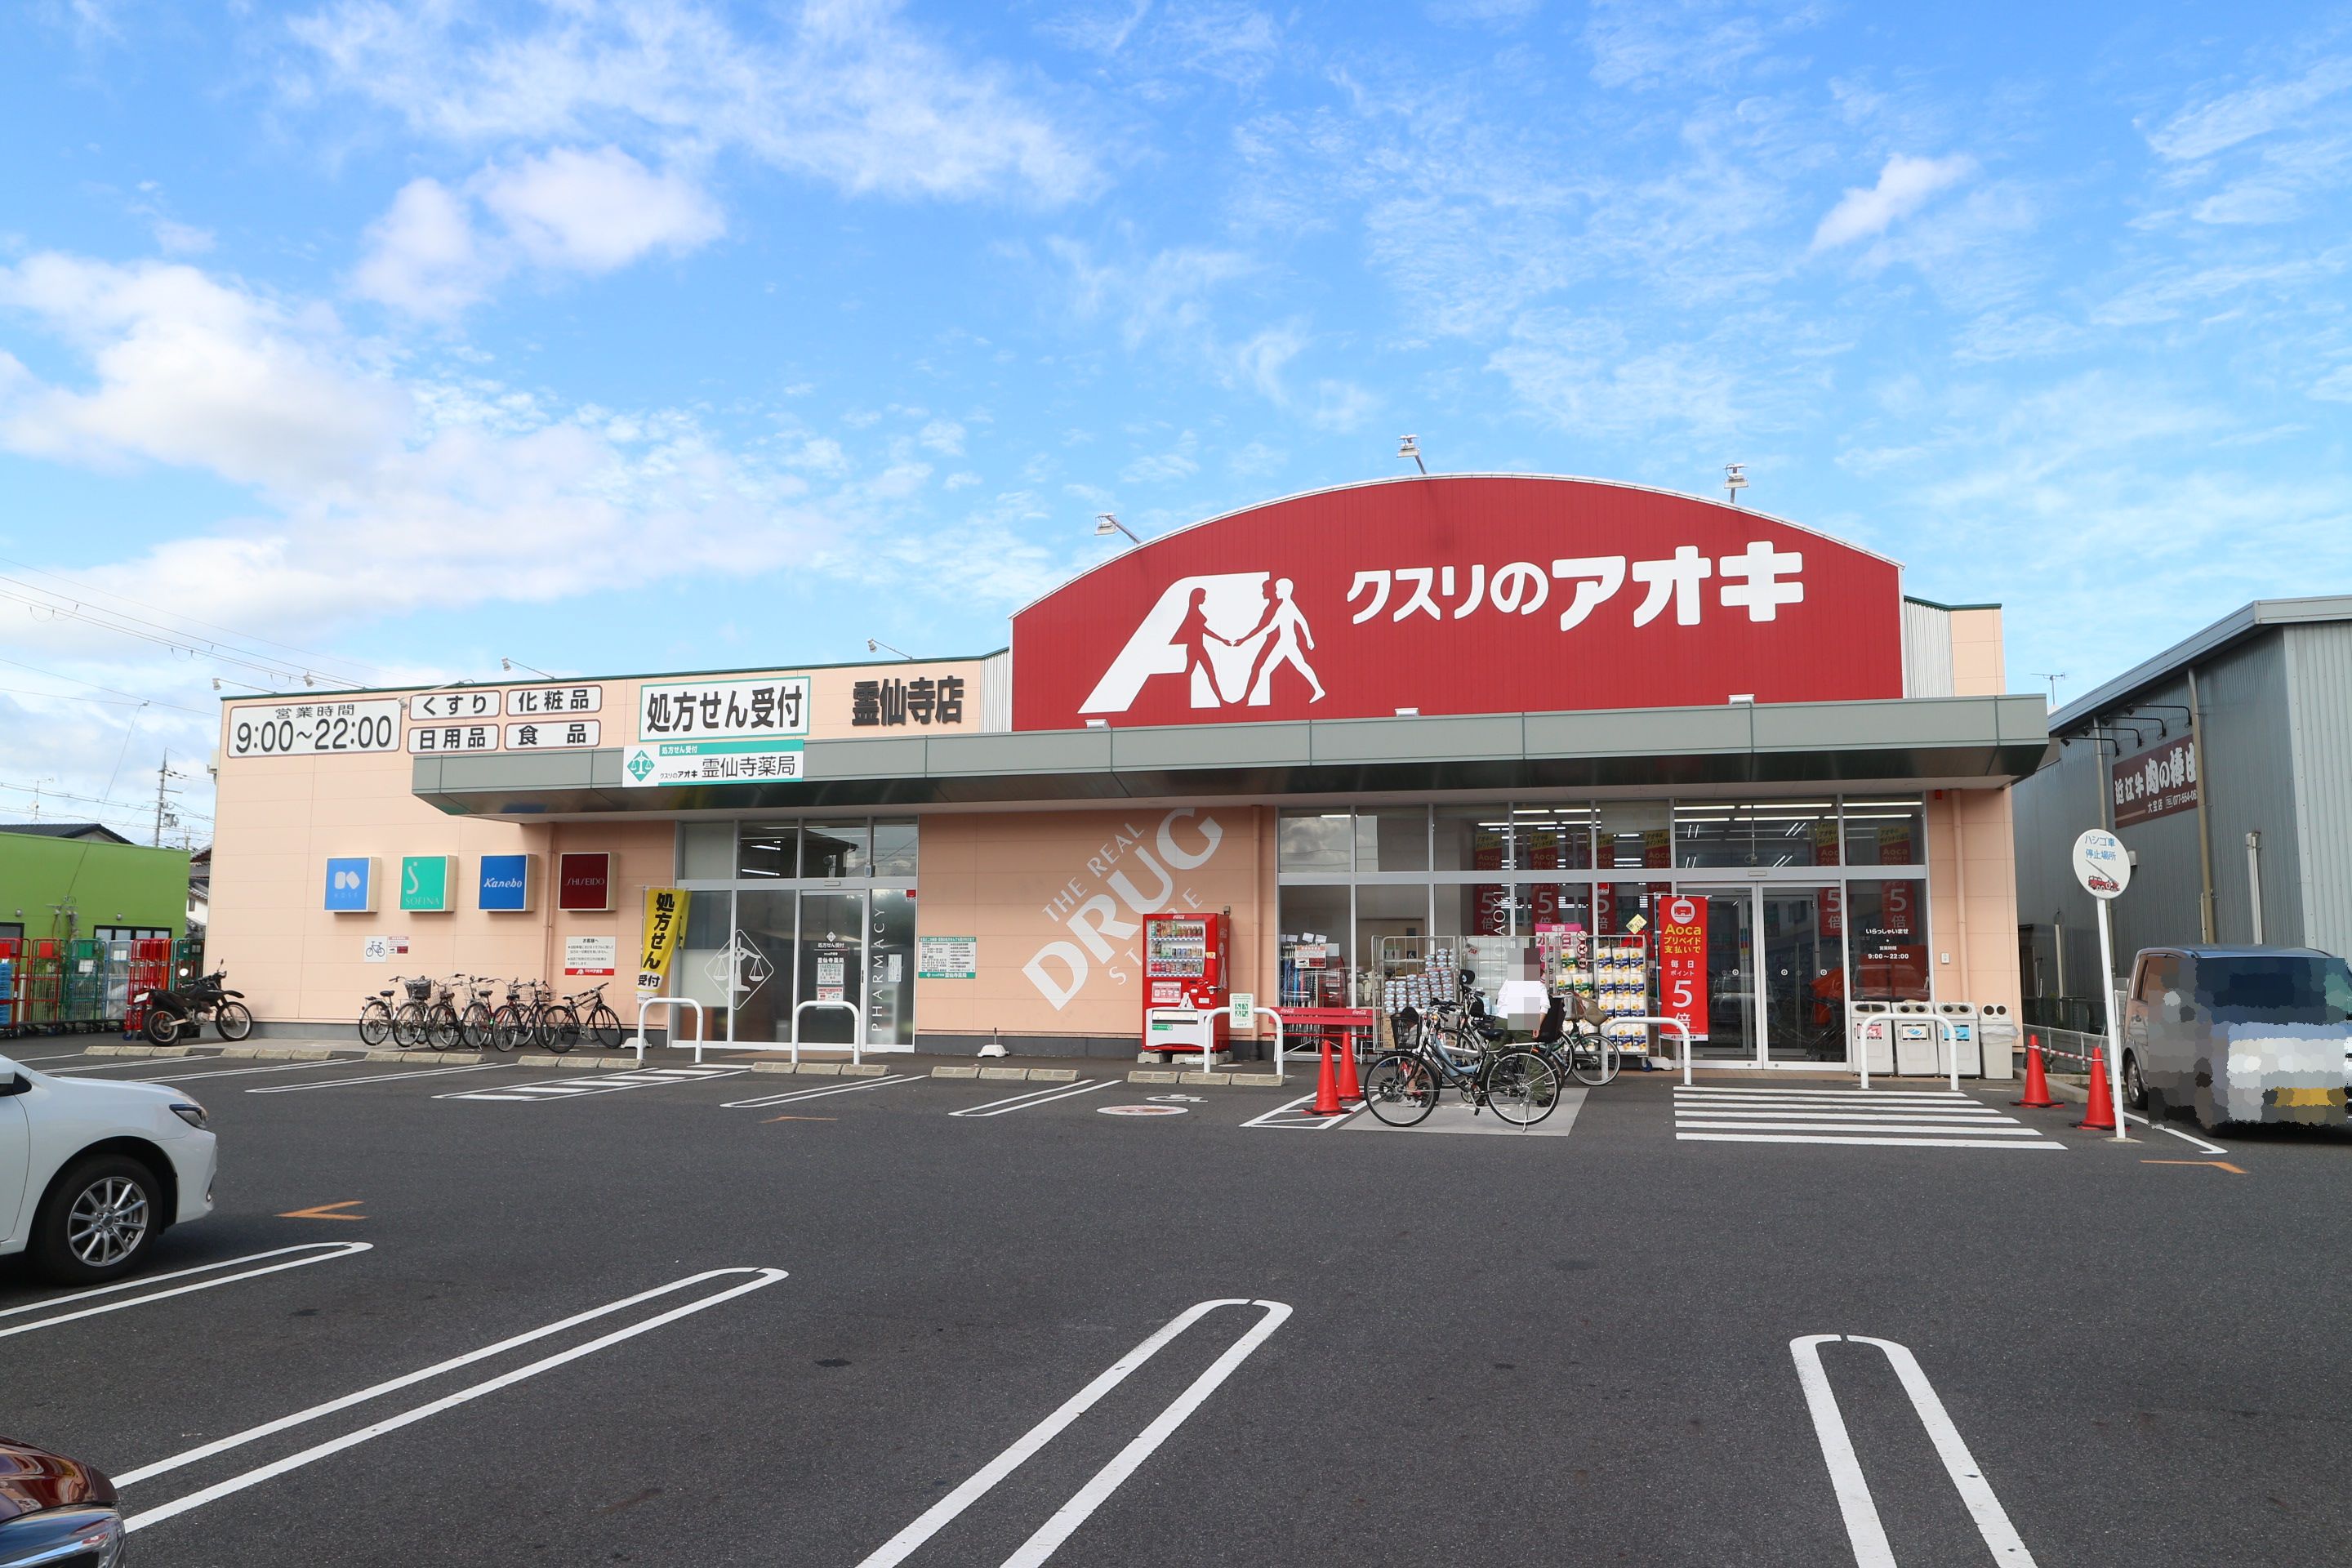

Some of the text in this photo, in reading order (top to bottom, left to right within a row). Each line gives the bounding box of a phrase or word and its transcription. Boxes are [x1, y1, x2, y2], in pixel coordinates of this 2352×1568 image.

[1346, 540, 1804, 632] クスリのアオキ
[275, 704, 354, 719] 営業時間
[422, 694, 488, 716] くすり
[518, 688, 590, 713] 化粧品
[647, 685, 803, 733] 処方せん受付
[852, 675, 964, 727] 霊仙寺店
[419, 727, 486, 751] 日用品
[662, 745, 698, 755] 処方せん受付
[660, 770, 698, 780] クスリのアオキ
[702, 755, 795, 778] 霊仙寺薬局
[2085, 835, 2116, 847] ハシゴ車
[2085, 849, 2117, 862] 停止場所
[483, 877, 523, 888] Kanebo
[566, 877, 605, 886] SHISEIDO
[1042, 822, 1144, 922] THE REAL
[405, 897, 440, 906] SOFINA
[1021, 807, 1224, 1012] DRUG
[1537, 892, 1553, 914] 5
[1890, 888, 1907, 912] 5
[1493, 891, 1506, 937] AOKI
[1891, 915, 1906, 928] 倍
[642, 892, 675, 969] 処方せん
[1108, 888, 1203, 986] STE
[1664, 924, 1702, 936] Aoca
[1664, 937, 1701, 945] プリペイド
[1664, 946, 1701, 954] 支払いで
[637, 974, 660, 987] 受付
[871, 908, 885, 1031] PHARMACY
[1672, 980, 1693, 1008] 5
